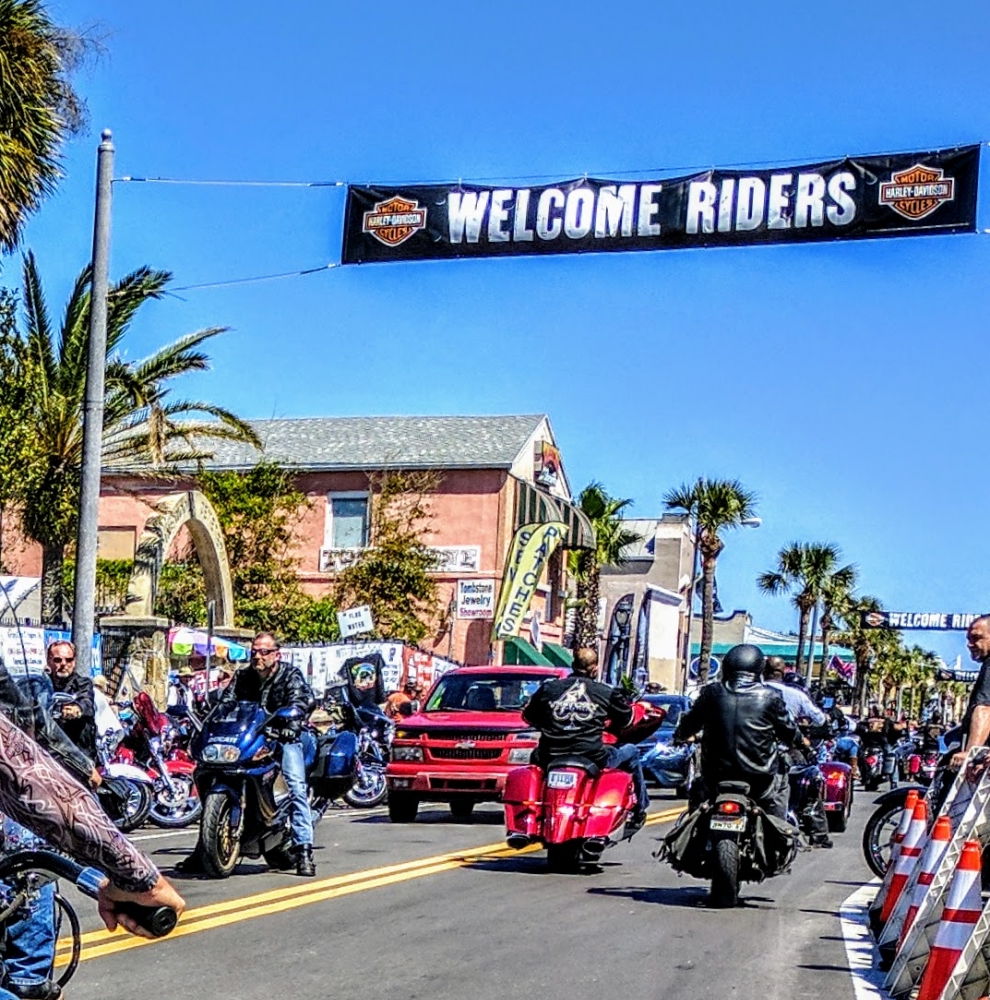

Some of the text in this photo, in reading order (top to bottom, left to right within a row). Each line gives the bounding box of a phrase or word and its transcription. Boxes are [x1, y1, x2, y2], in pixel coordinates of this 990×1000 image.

[899, 170, 937, 184] MOTOR
[886, 183, 948, 199] HARLEY-DAVIDSON
[379, 201, 410, 213] MOTOR
[447, 171, 857, 243] WELCOME RIDERS
[898, 199, 933, 214] CYCLES
[368, 213, 421, 226] HARLEY-DAVIDSON
[378, 228, 408, 239] CYCLES
[501, 526, 558, 632] PATCHES
[460, 582, 492, 593] Tombstone
[461, 595, 491, 607] Jewelry
[459, 607, 492, 617] Showroom
[889, 612, 947, 628] WELCOME
